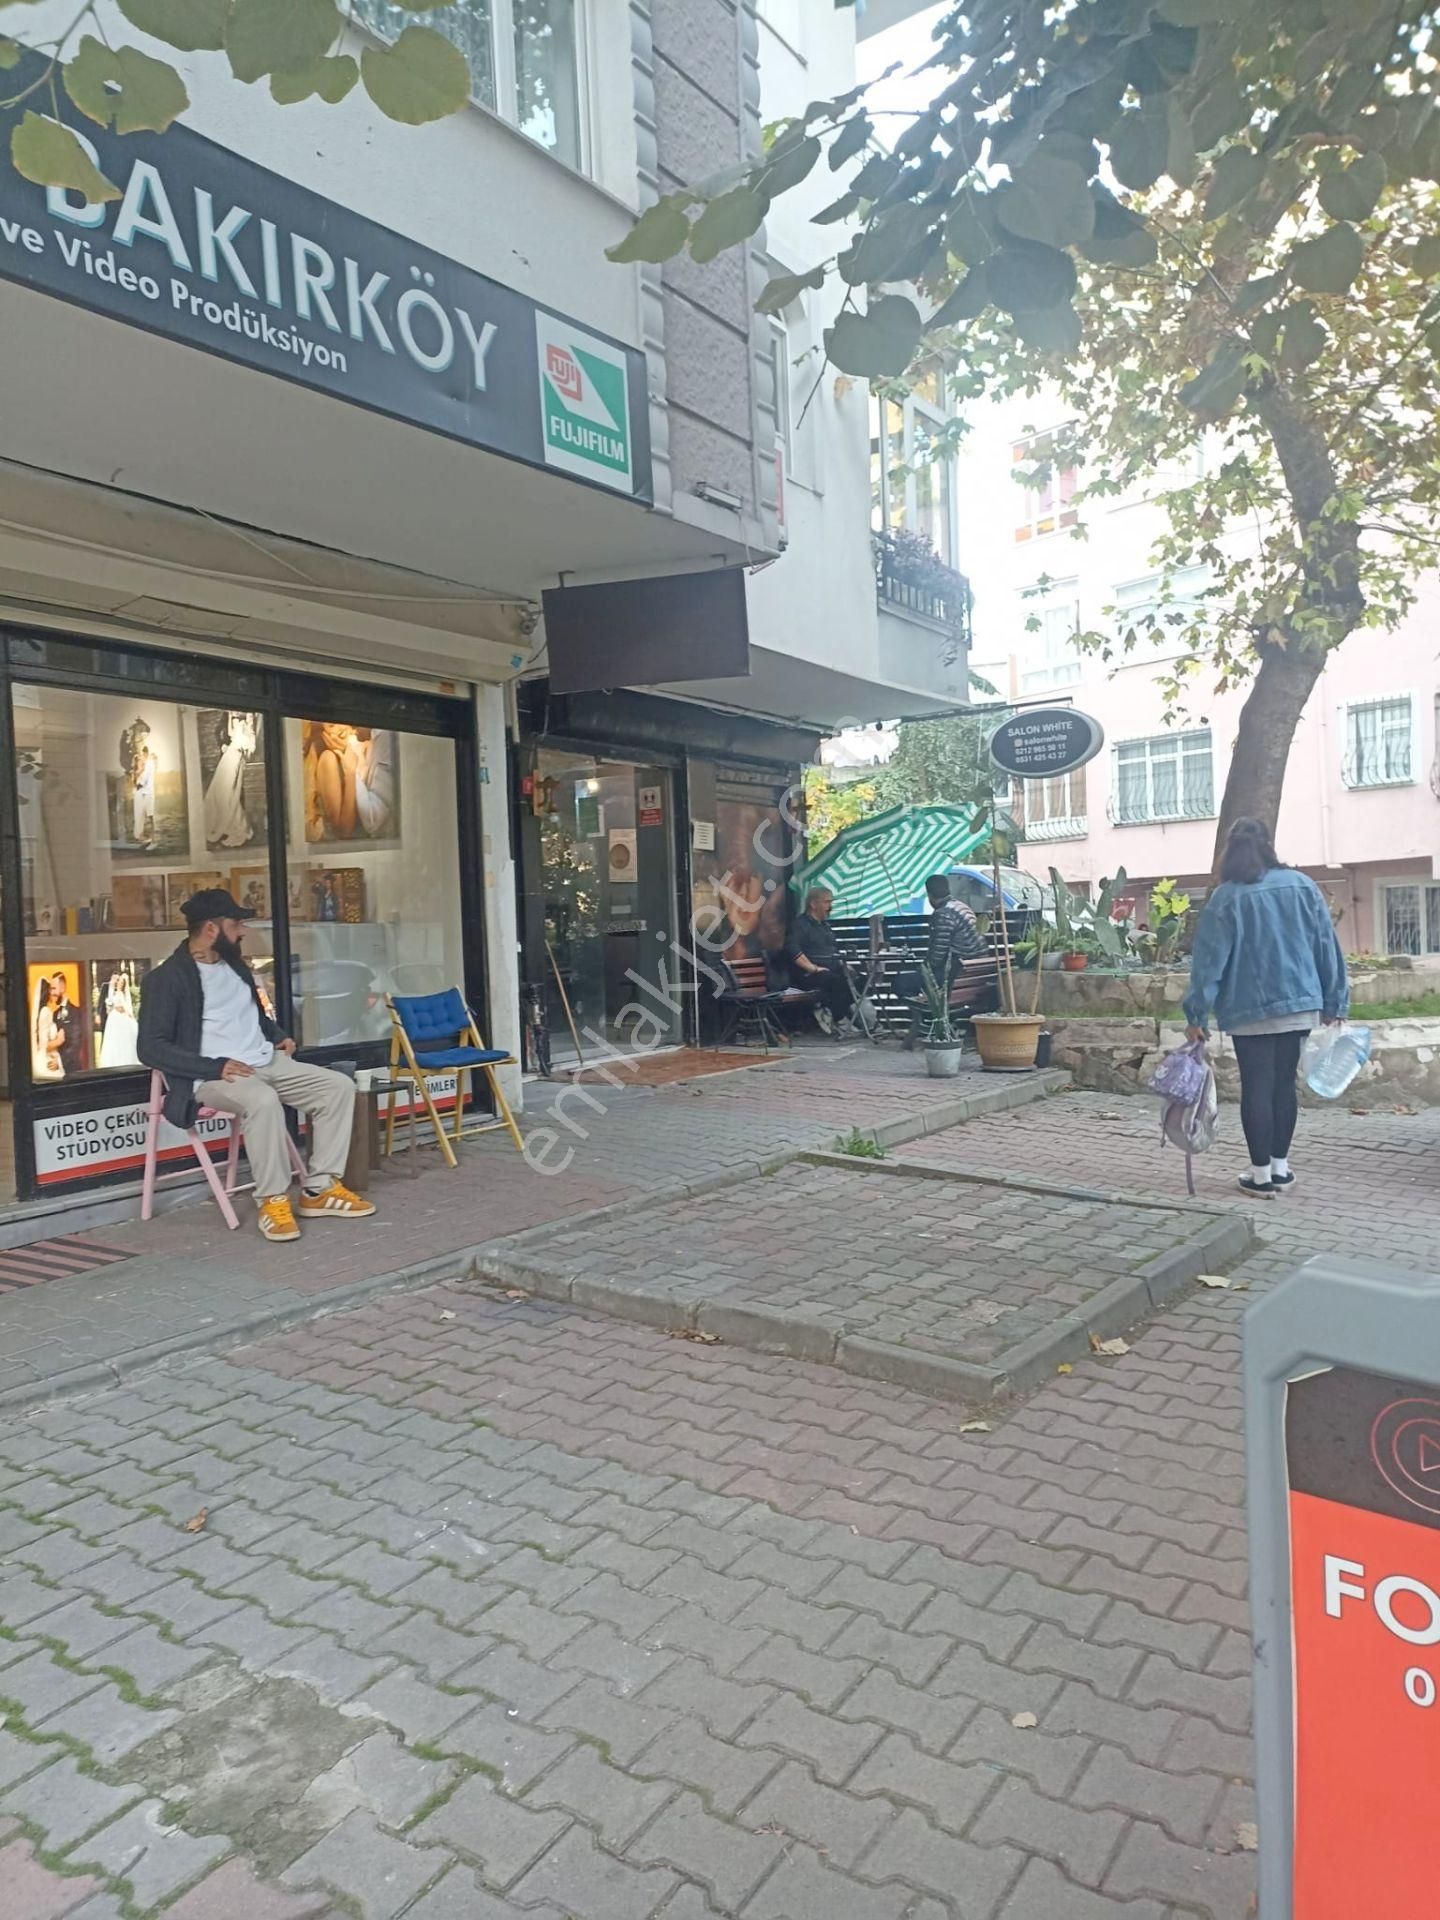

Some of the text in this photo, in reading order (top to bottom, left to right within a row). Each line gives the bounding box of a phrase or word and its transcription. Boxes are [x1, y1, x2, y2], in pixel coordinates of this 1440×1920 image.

[0, 217, 348, 373] ve Video Prodüksiyon
[550, 414, 625, 463] FUJIFILM
[1008, 726, 1040, 737] SALON
[1025, 734, 1067, 745] salonwhite
[1015, 746, 1032, 756] 0212
[1059, 743, 1066, 751] 11
[44, 1118, 98, 1141] VİDEO
[56, 1131, 146, 1160] STÜDYOSU
